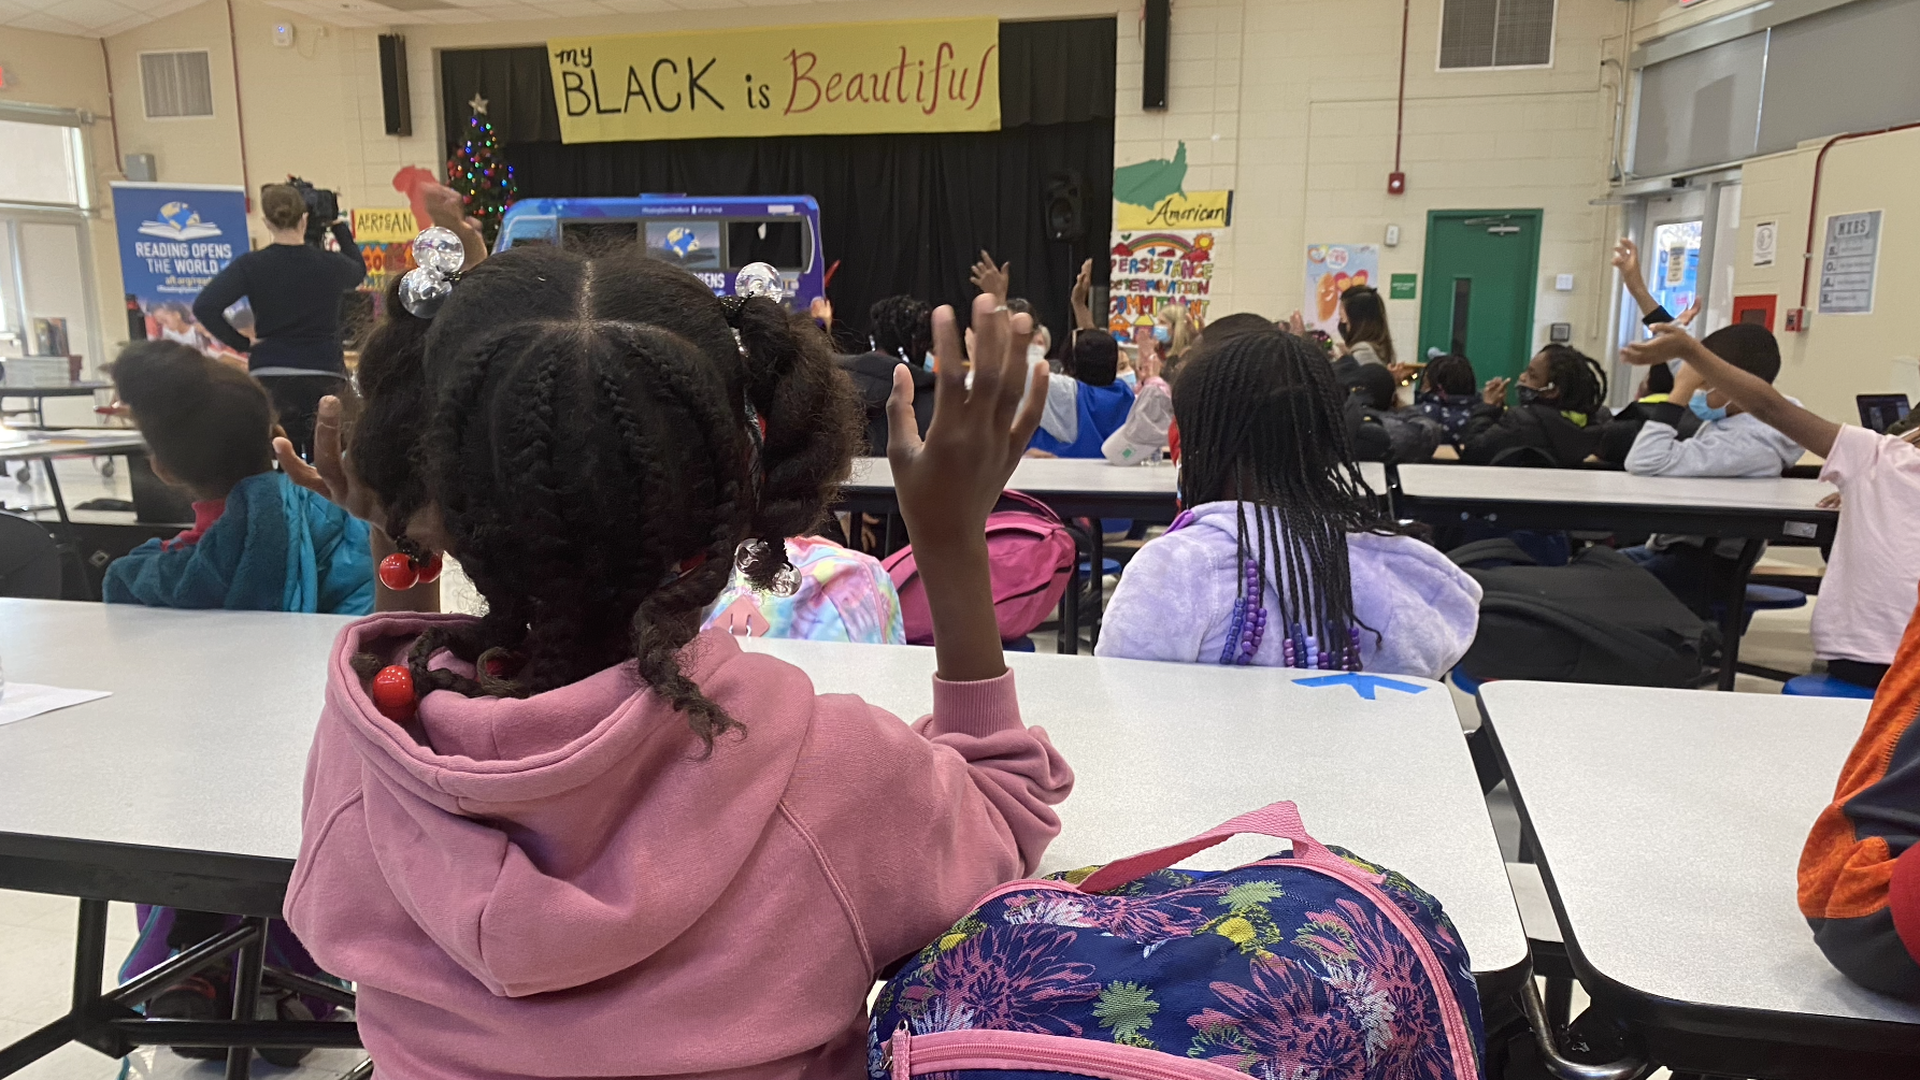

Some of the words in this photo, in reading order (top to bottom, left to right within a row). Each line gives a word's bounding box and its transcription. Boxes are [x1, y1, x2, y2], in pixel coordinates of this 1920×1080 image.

[562, 56, 725, 117] BLACK
[745, 73, 771, 110] is
[783, 41, 997, 116] Beautiful
[1147, 198, 1226, 227] American
[135, 242, 190, 258] READING
[191, 243, 232, 259] OPENS
[146, 258, 172, 274] THE
[174, 259, 219, 275] WORLD
[1110, 294, 1210, 318] COMMITNT
